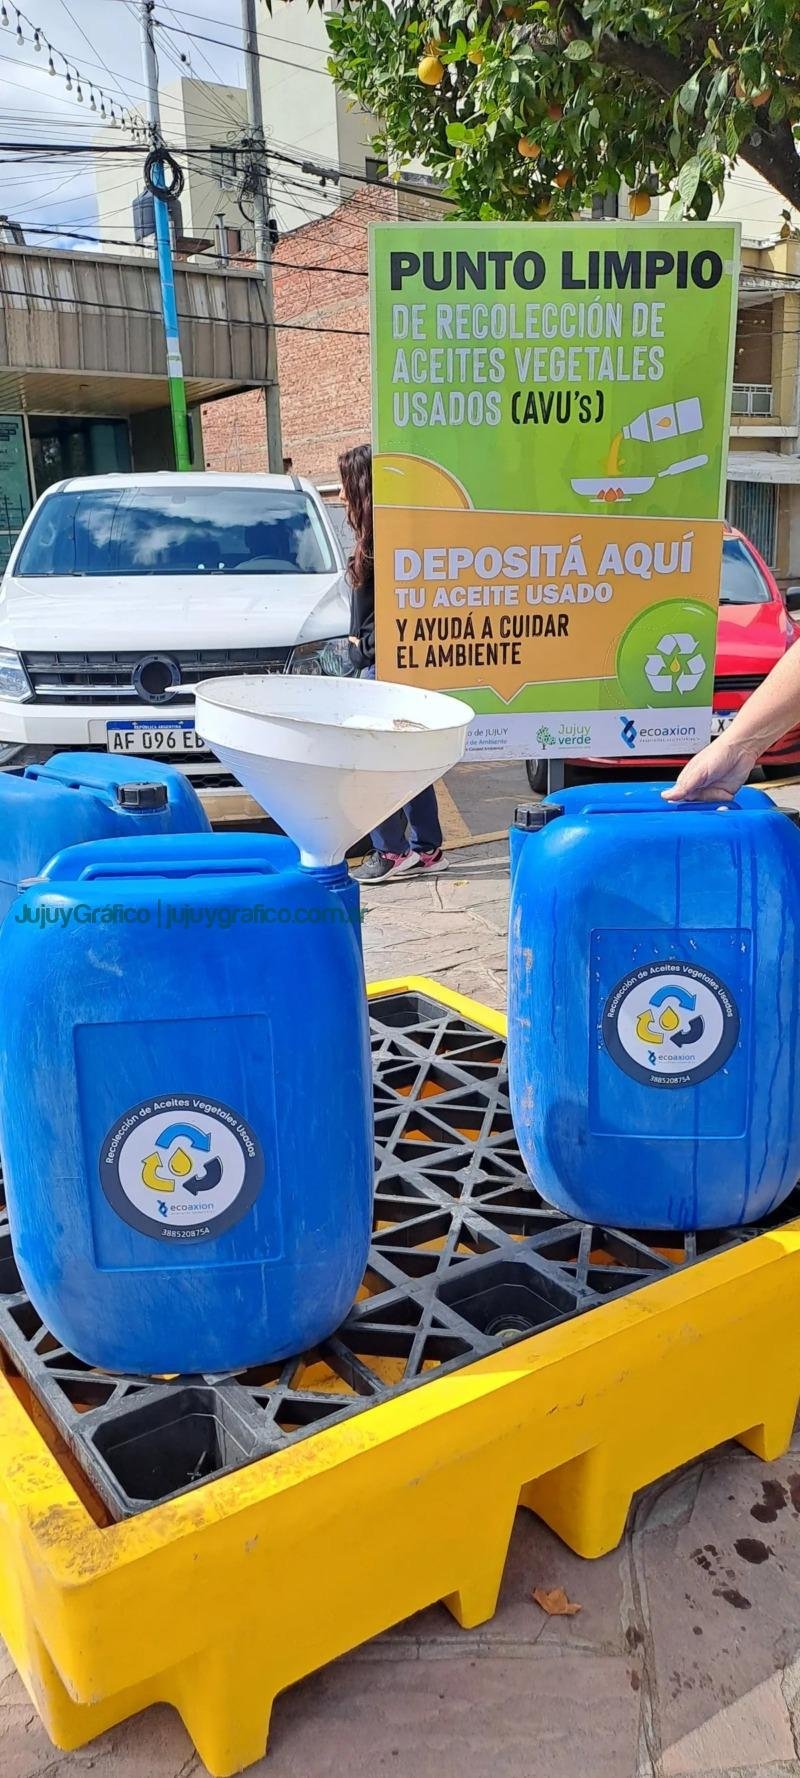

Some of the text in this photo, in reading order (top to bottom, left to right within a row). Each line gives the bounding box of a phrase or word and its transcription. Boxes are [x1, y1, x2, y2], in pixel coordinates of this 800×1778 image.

[390, 249, 723, 291] PUNTO LIMPIO
[392, 296, 665, 340] DE RECOLECCIÓN DE
[392, 345, 665, 384] ACEITES VEGETALES
[392, 390, 604, 427] USADOS (AVU's)
[393, 531, 695, 582] DEPOSITÁ AQUÍ
[395, 582, 613, 609] TU ACEITE USADO
[396, 611, 569, 642] Y AYUDÁ A CUIDAR
[397, 642, 522, 669] EL AMBIENTE
[114, 732, 134, 750] AF
[142, 731, 176, 749] 096
[474, 728, 484, 737] de
[485, 727, 509, 738] JUJUY
[558, 724, 591, 736] Jujuy
[559, 735, 591, 745] verde
[640, 726, 696, 737] ecoaxion
[607, 964, 733, 1018] Recolección de Aceites Vegetales Usados
[105, 1098, 256, 1164] Recolección de Aceites Vegetales Usados
[170, 1202, 214, 1211] ecoaxion
